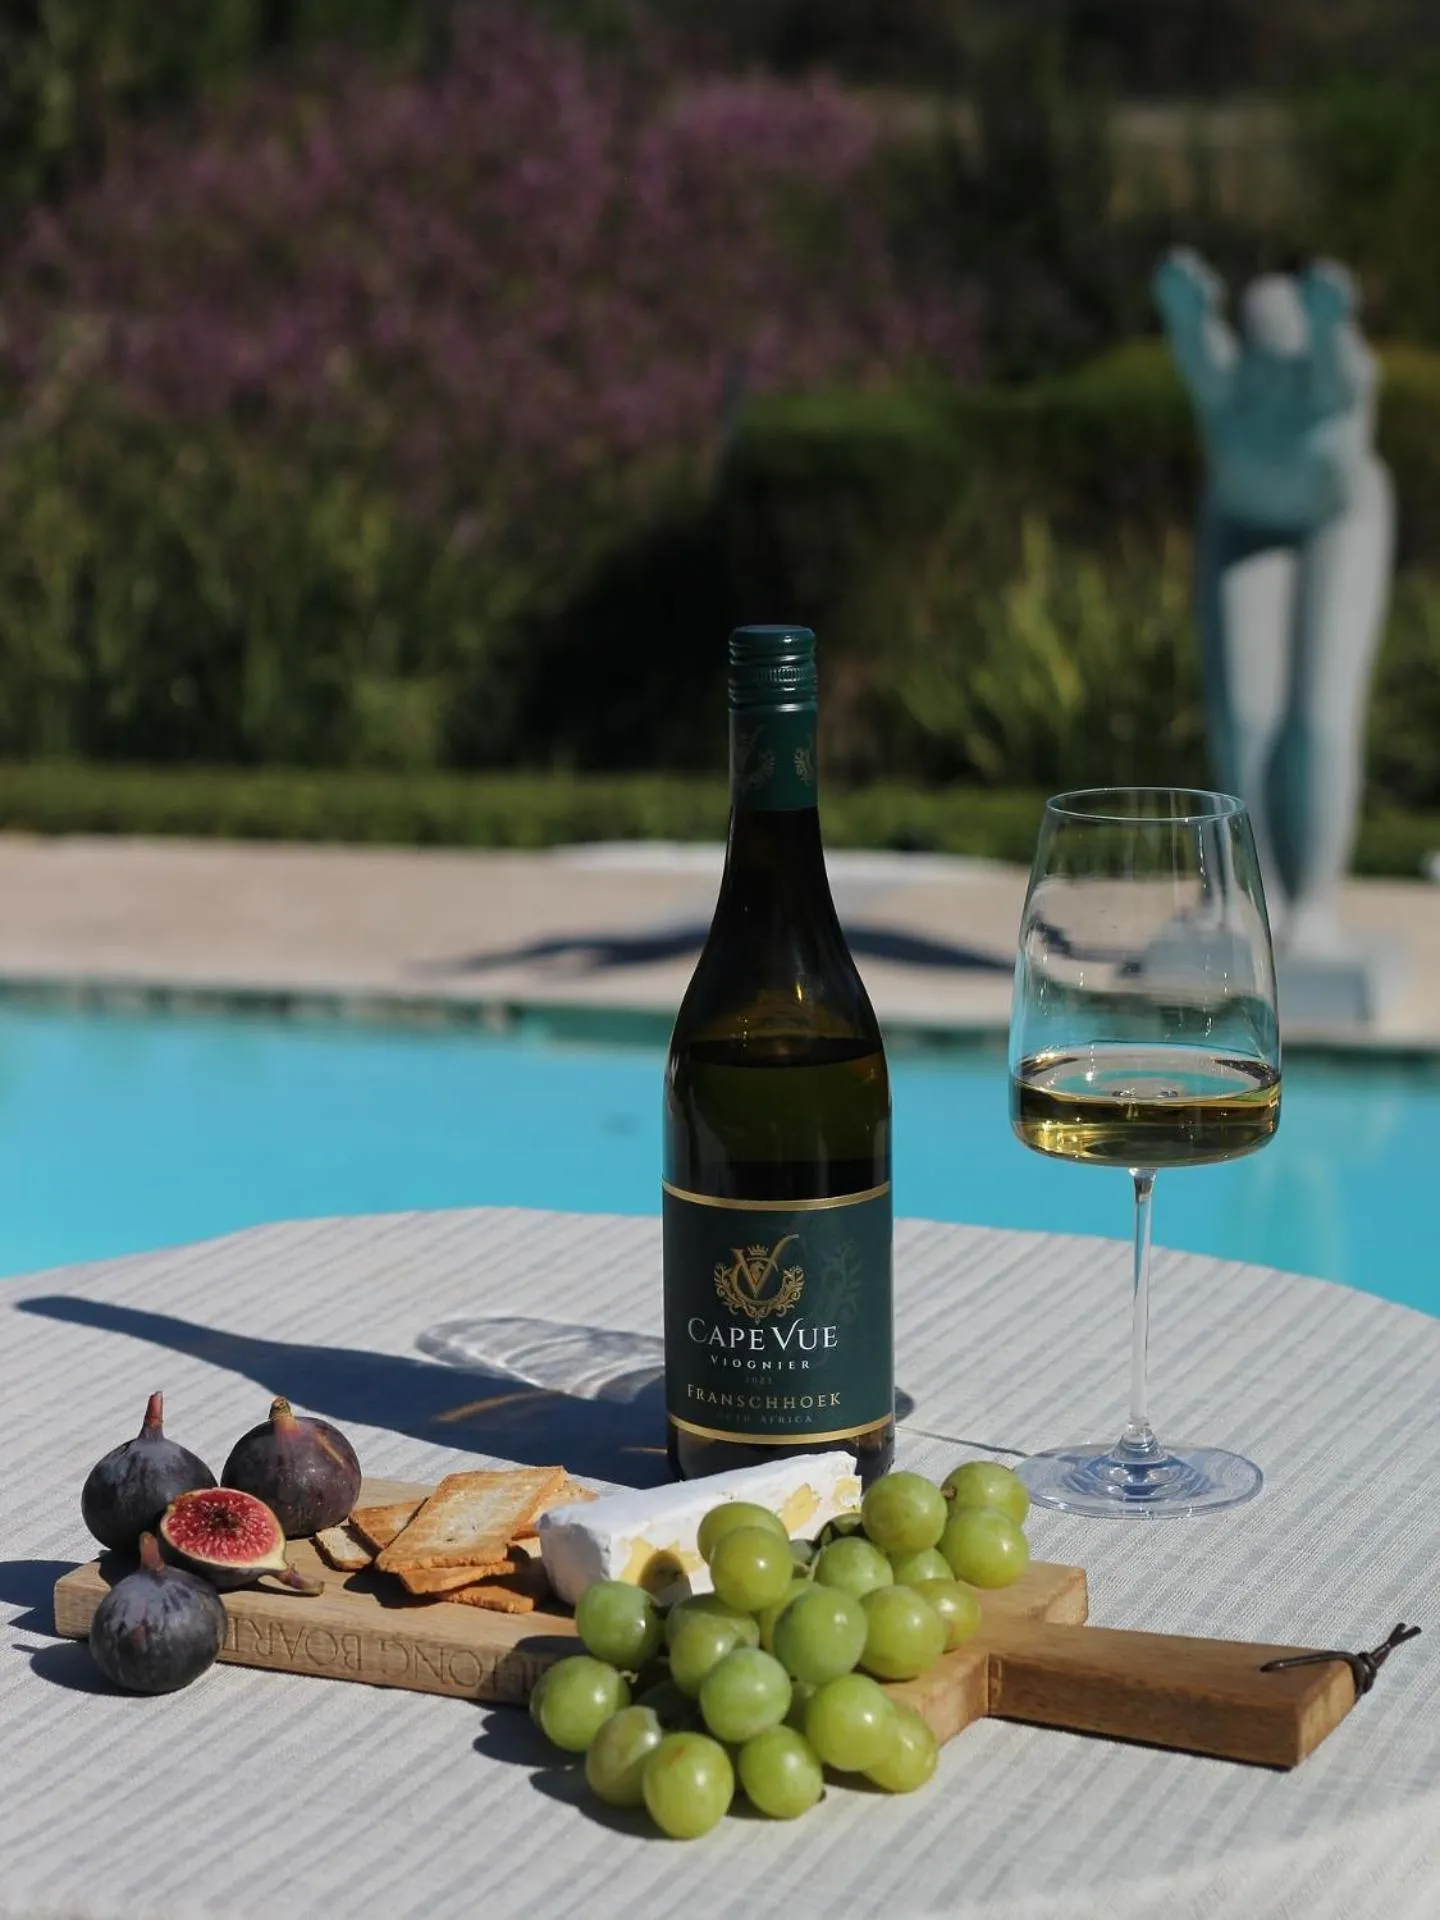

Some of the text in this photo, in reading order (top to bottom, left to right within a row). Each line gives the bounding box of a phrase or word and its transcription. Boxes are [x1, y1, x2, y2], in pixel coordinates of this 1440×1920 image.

[687, 1317, 838, 1350] CAPE VUE
[709, 1354, 811, 1370] VIOGNIER
[687, 1383, 841, 1409] FRANSCHHOEK
